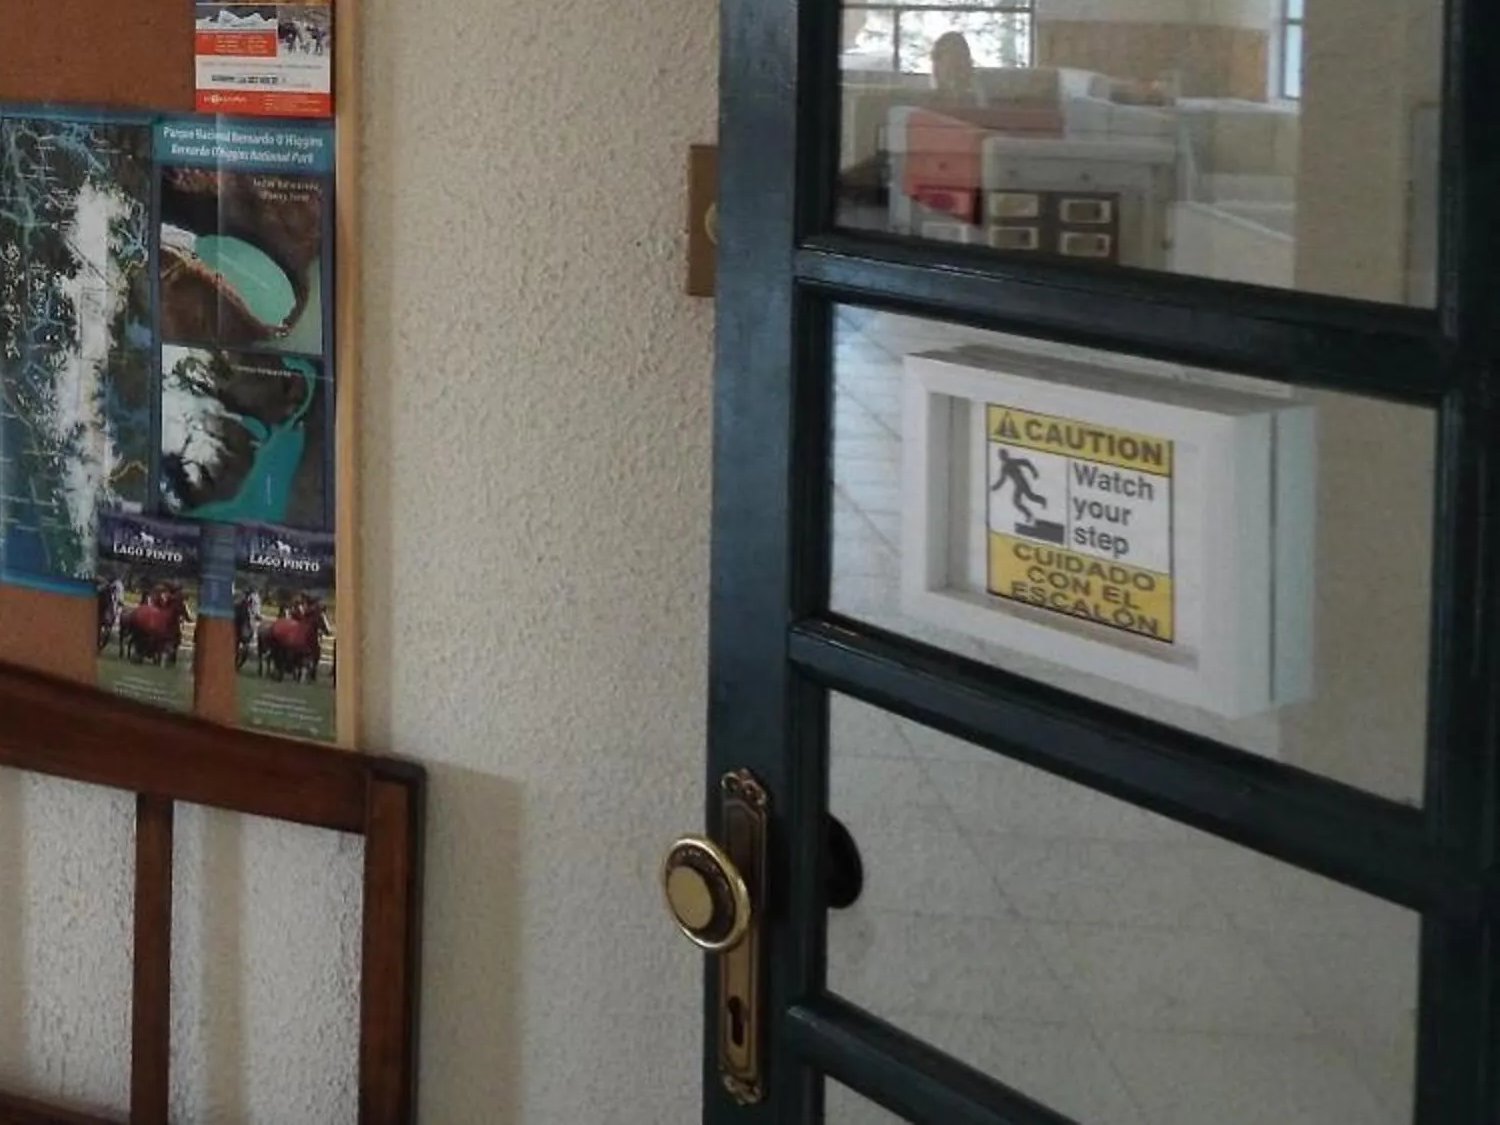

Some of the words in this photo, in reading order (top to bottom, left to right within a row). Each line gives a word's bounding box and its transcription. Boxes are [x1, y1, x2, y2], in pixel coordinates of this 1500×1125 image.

[1024, 419, 1163, 465] CAUTION
[1073, 462, 1155, 500] Watch
[1073, 497, 1132, 525] your
[113, 542, 143, 557] LAGO
[146, 547, 183, 563] PINTO
[1073, 525, 1130, 558] step
[250, 553, 281, 569] LAGO
[283, 557, 320, 573] PINTO
[1012, 543, 1156, 592] CUIDADO
[1027, 565, 1092, 597] CON
[1102, 586, 1141, 610] EL
